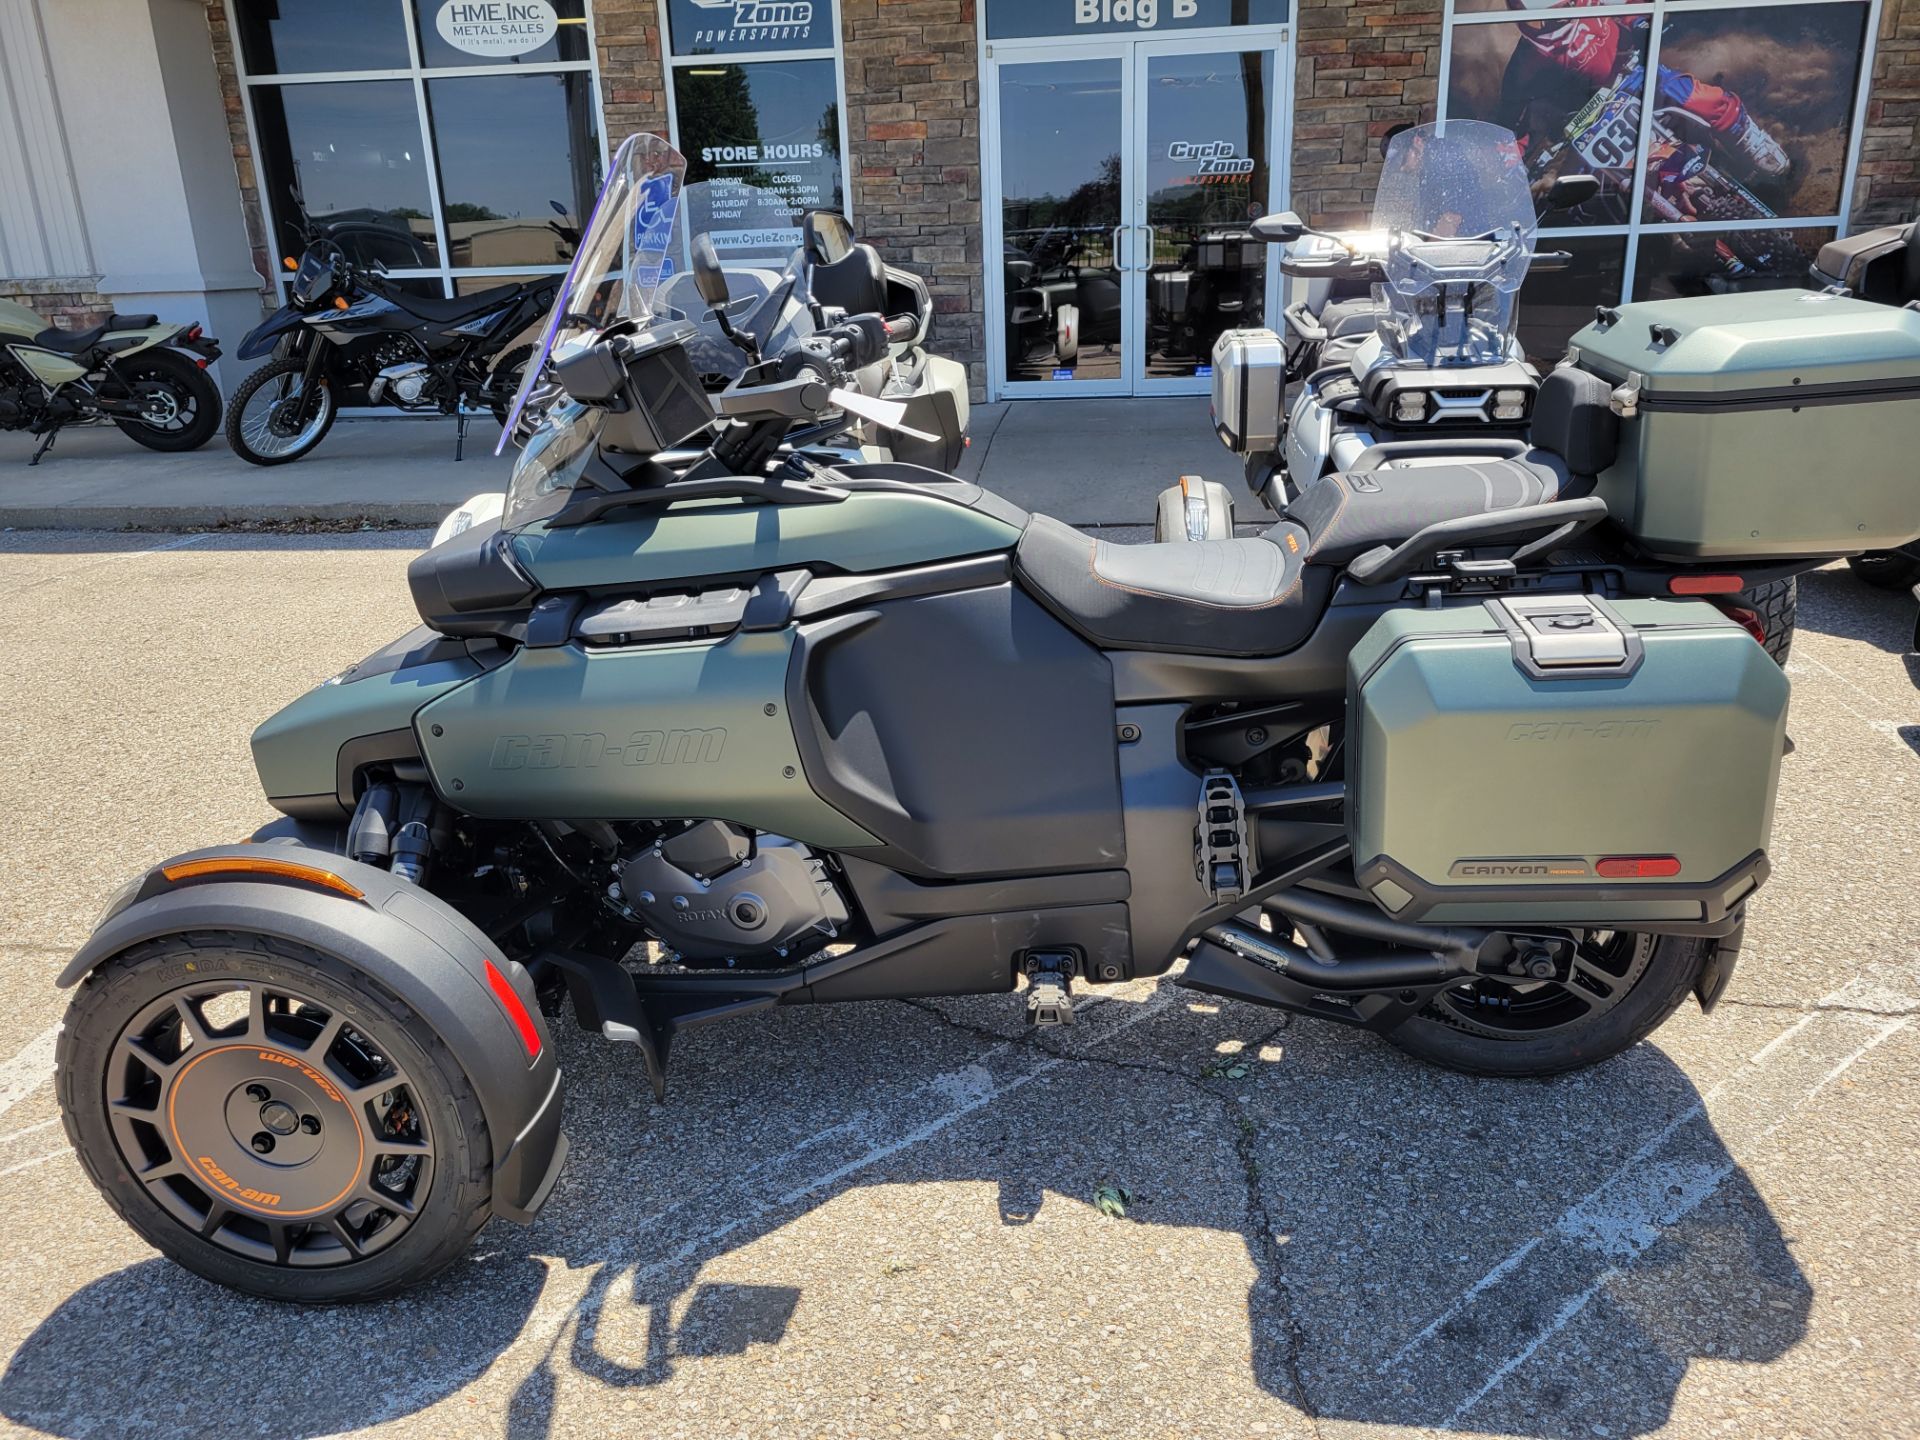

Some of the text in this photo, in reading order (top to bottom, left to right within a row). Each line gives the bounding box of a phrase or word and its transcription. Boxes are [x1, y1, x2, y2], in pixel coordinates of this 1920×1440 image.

[734, 2, 813, 27] Zone
[1075, 0, 1198, 28] Bldg B
[453, 24, 544, 36] METAL SALES
[695, 26, 811, 43] POWERSPORTS
[702, 143, 823, 162] STORE HOURS
[1168, 141, 1234, 160] Cycle
[1198, 157, 1255, 174] Zone
[709, 174, 802, 186] MONDAY CLOSED
[1168, 174, 1253, 185] ERSPORTS
[711, 189, 729, 198] TUES
[738, 188, 750, 197] FRI
[711, 199, 749, 208] SATURDAY
[712, 208, 804, 219] SUNDAY CLOSED
[1504, 719, 1663, 743] can-am
[488, 727, 728, 770] can-am
[1461, 866, 1548, 875] CANYON
[678, 907, 728, 923] ROTAX
[156, 957, 229, 984] KENDA
[259, 1052, 342, 1102] can-am
[198, 1156, 281, 1205] can-am
